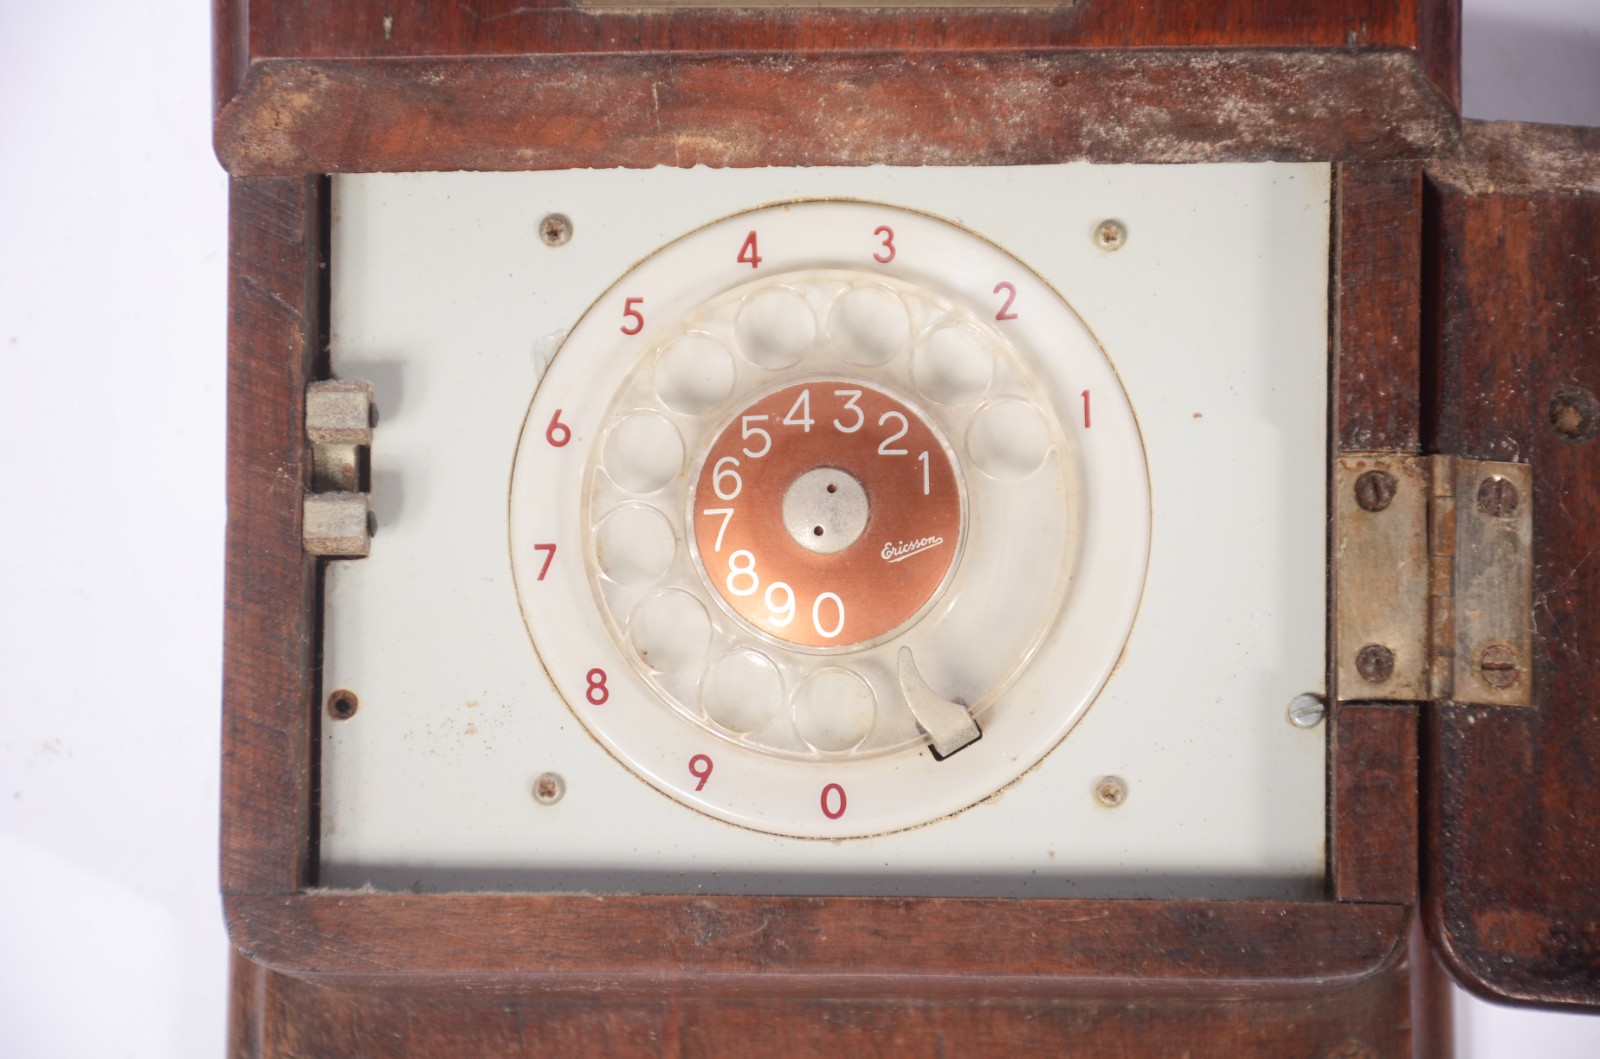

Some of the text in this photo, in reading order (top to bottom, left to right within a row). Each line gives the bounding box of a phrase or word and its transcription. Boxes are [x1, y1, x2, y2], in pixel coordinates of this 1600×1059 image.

[736, 230, 763, 269] 4
[873, 225, 896, 264] 3
[620, 297, 645, 336] 5
[994, 282, 1018, 321] 2
[545, 409, 572, 449] 6
[782, 389, 816, 433] 4
[833, 389, 865, 434] 3
[1081, 389, 1091, 429] 1
[741, 414, 772, 459] 5
[877, 410, 910, 456] 2
[712, 456, 743, 501] 6
[917, 450, 931, 496] 1
[703, 507, 735, 553] 7
[880, 534, 944, 564] Ericsson
[533, 543, 558, 581] 7
[726, 549, 760, 597] 8
[764, 581, 796, 628] 9
[812, 591, 846, 639] 0
[585, 667, 610, 706] 8
[687, 753, 715, 792] 9
[819, 782, 848, 821] 0
